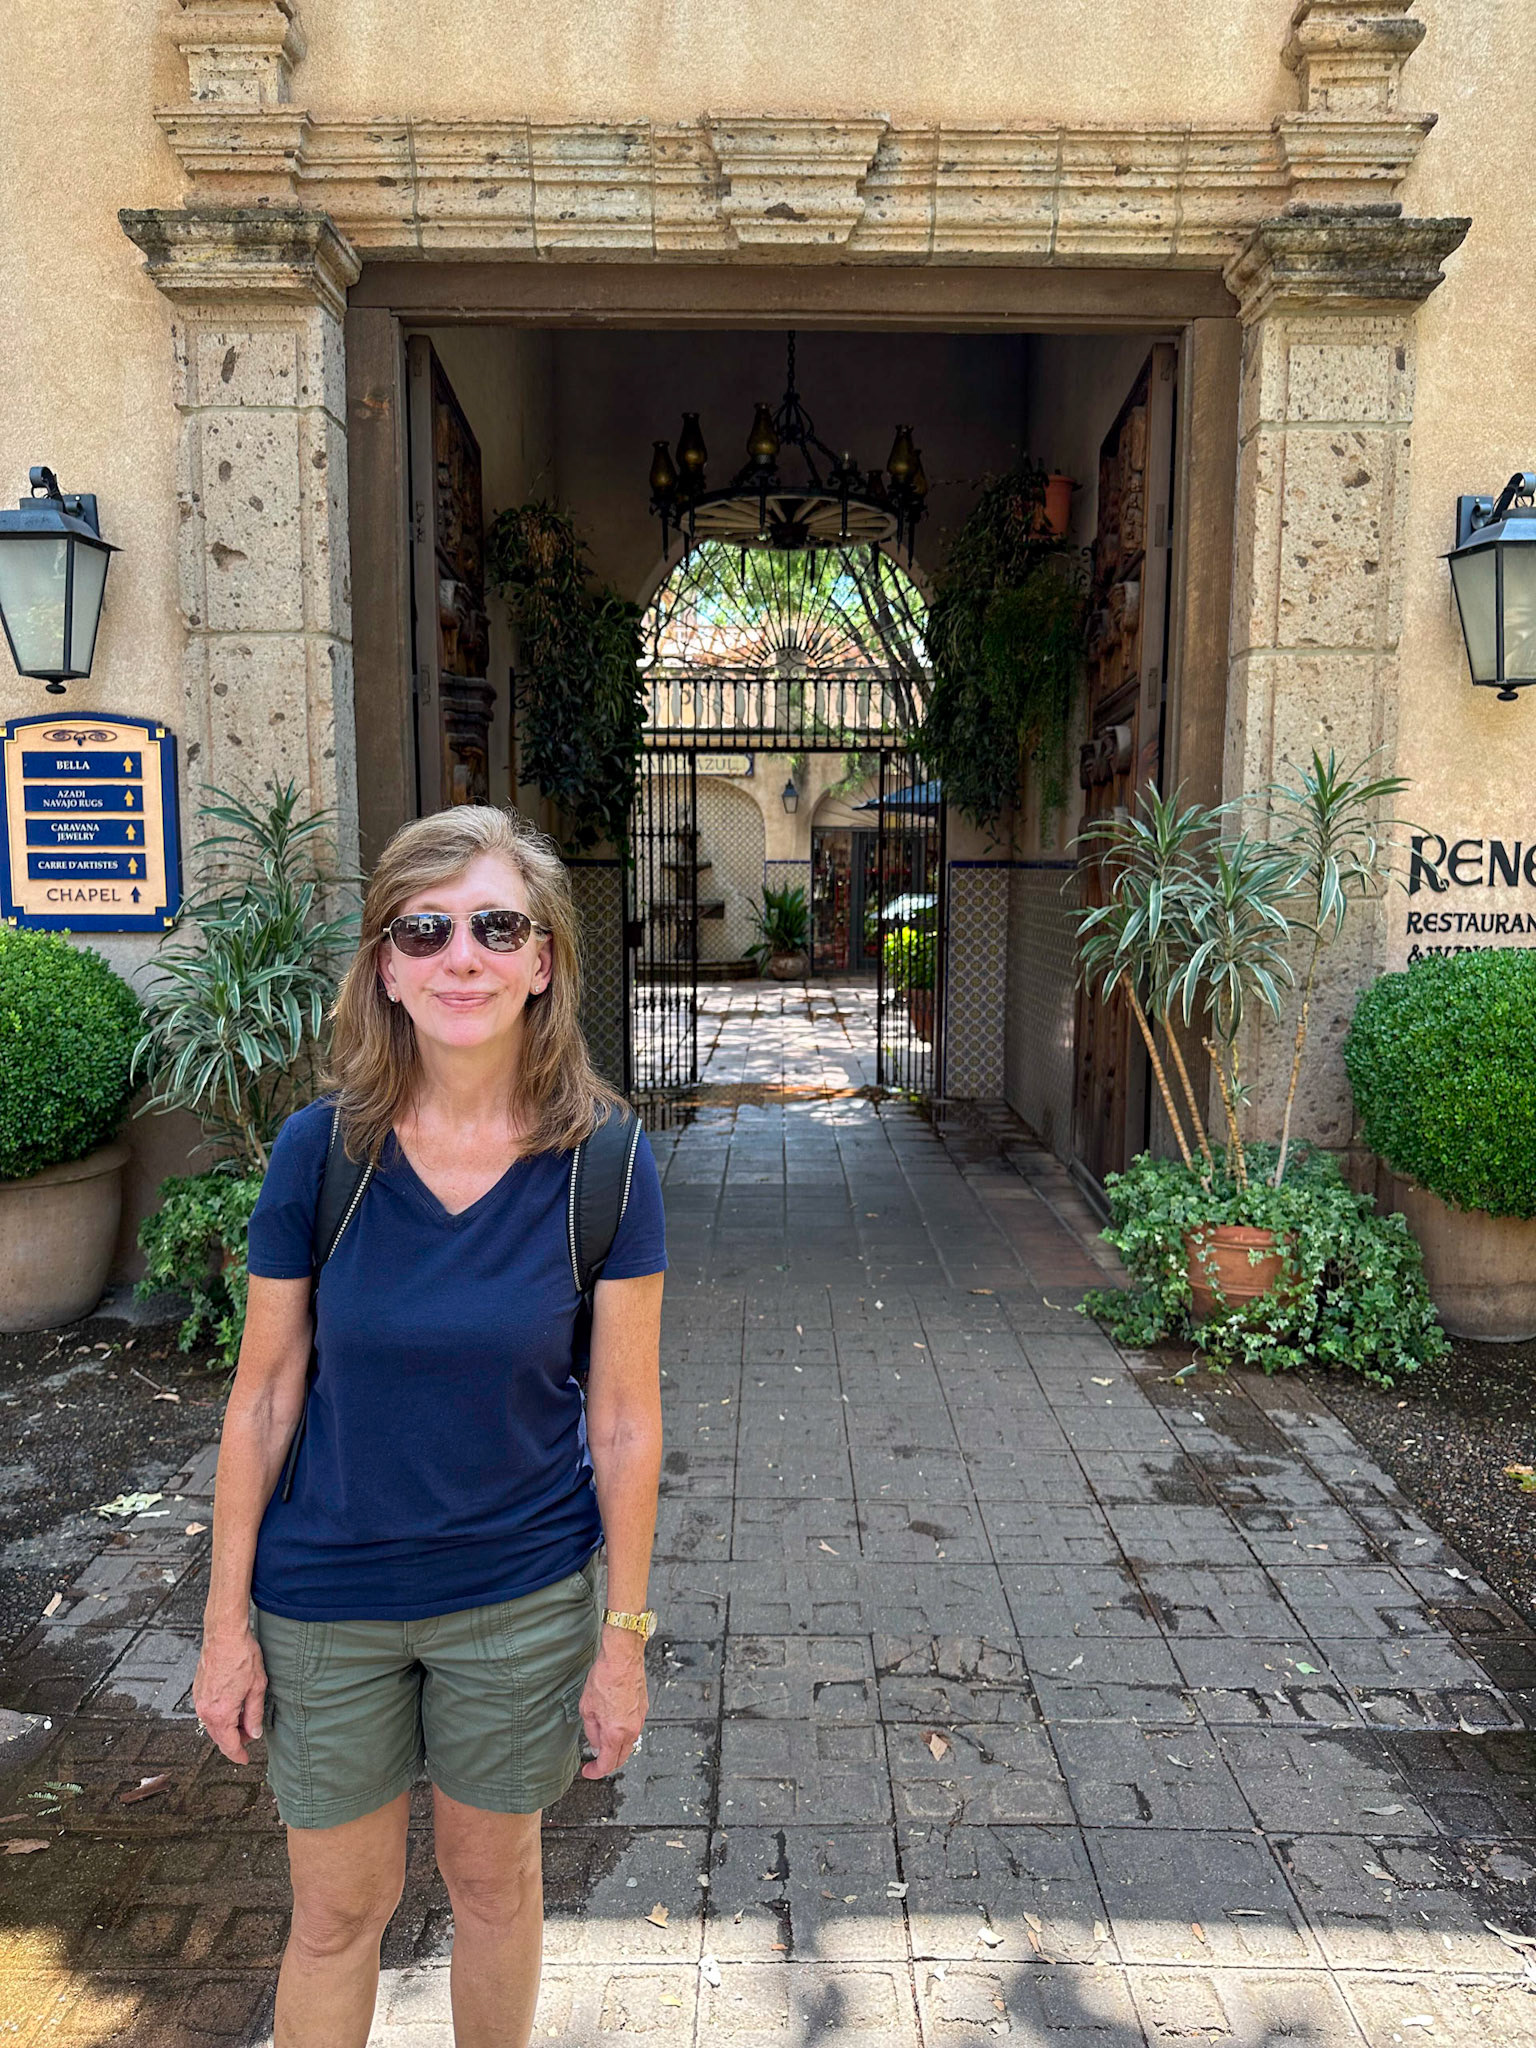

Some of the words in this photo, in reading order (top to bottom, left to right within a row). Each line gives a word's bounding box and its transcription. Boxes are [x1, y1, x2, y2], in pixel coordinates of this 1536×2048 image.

[56, 760, 91, 770] BELLA
[57, 790, 86, 799] AZADI
[43, 799, 78, 809] NAVAJO
[79, 799, 104, 808] RUGS
[51, 823, 100, 832] CARAVANA
[57, 832, 95, 842] JEWELRY
[38, 861, 68, 870] CARRE
[68, 861, 119, 870] D'ARTISTES
[46, 888, 121, 902] CHAPEL
